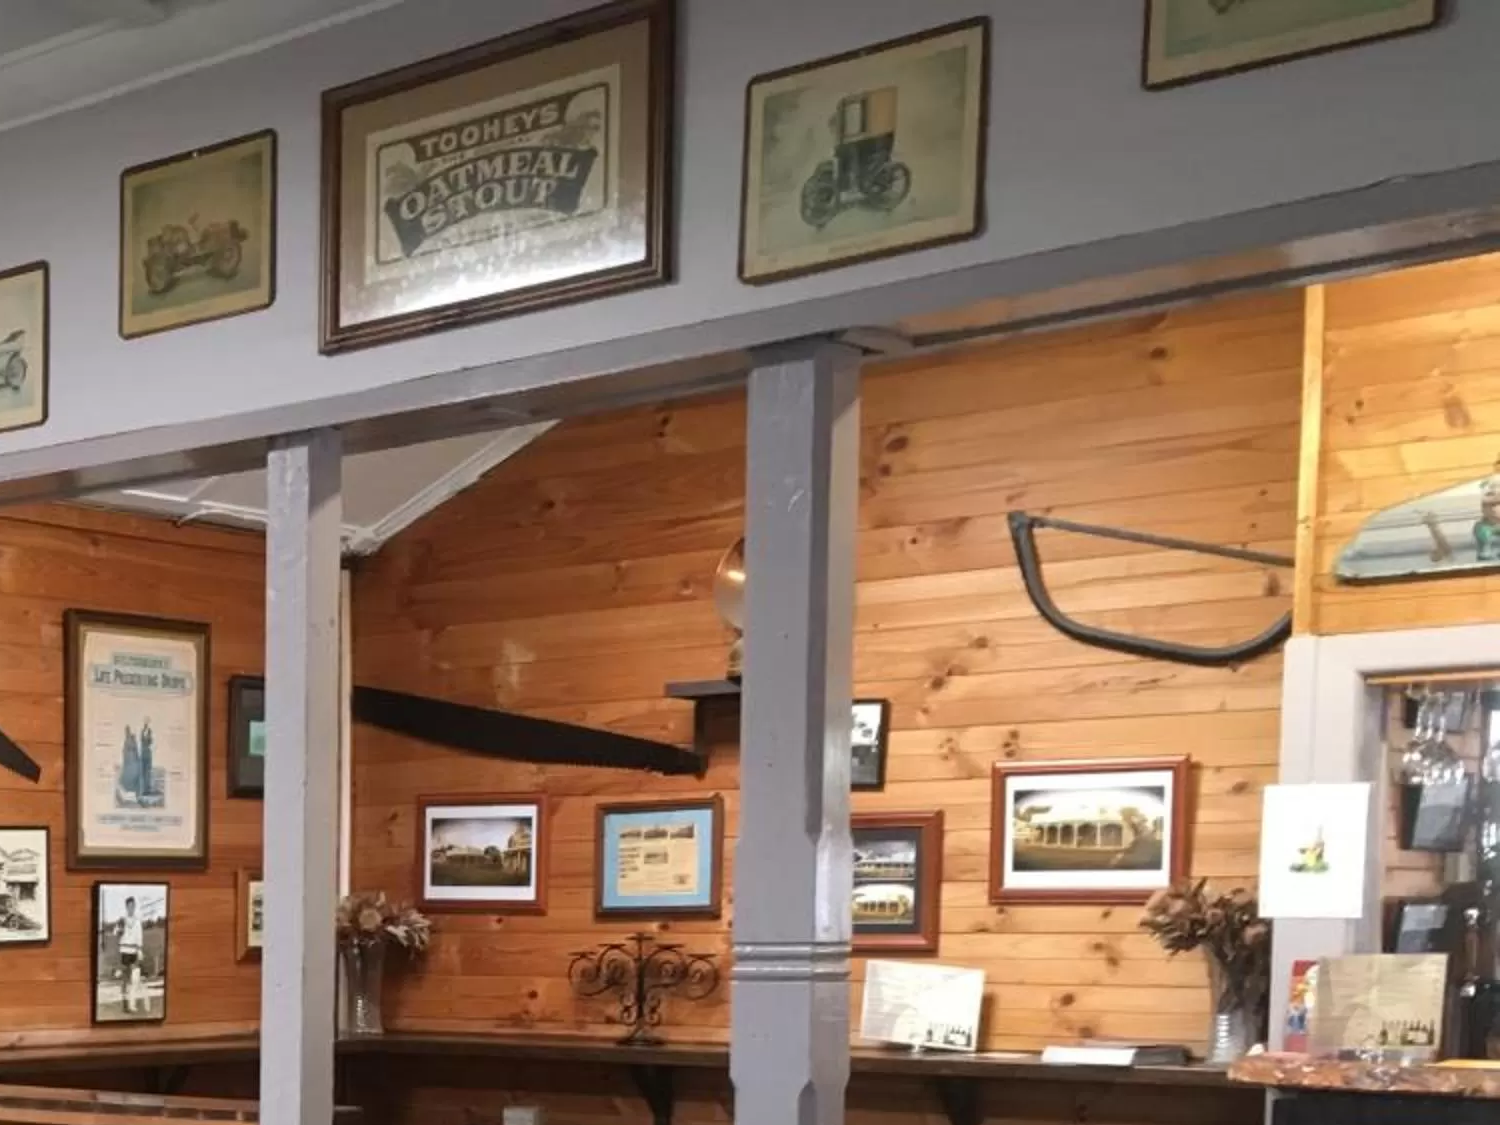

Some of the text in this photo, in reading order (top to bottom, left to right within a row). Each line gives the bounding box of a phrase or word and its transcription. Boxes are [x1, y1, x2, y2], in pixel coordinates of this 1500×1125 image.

[420, 102, 559, 158] TOOHEYS
[399, 150, 578, 221] OATMEAL
[421, 178, 556, 234] STOUT
